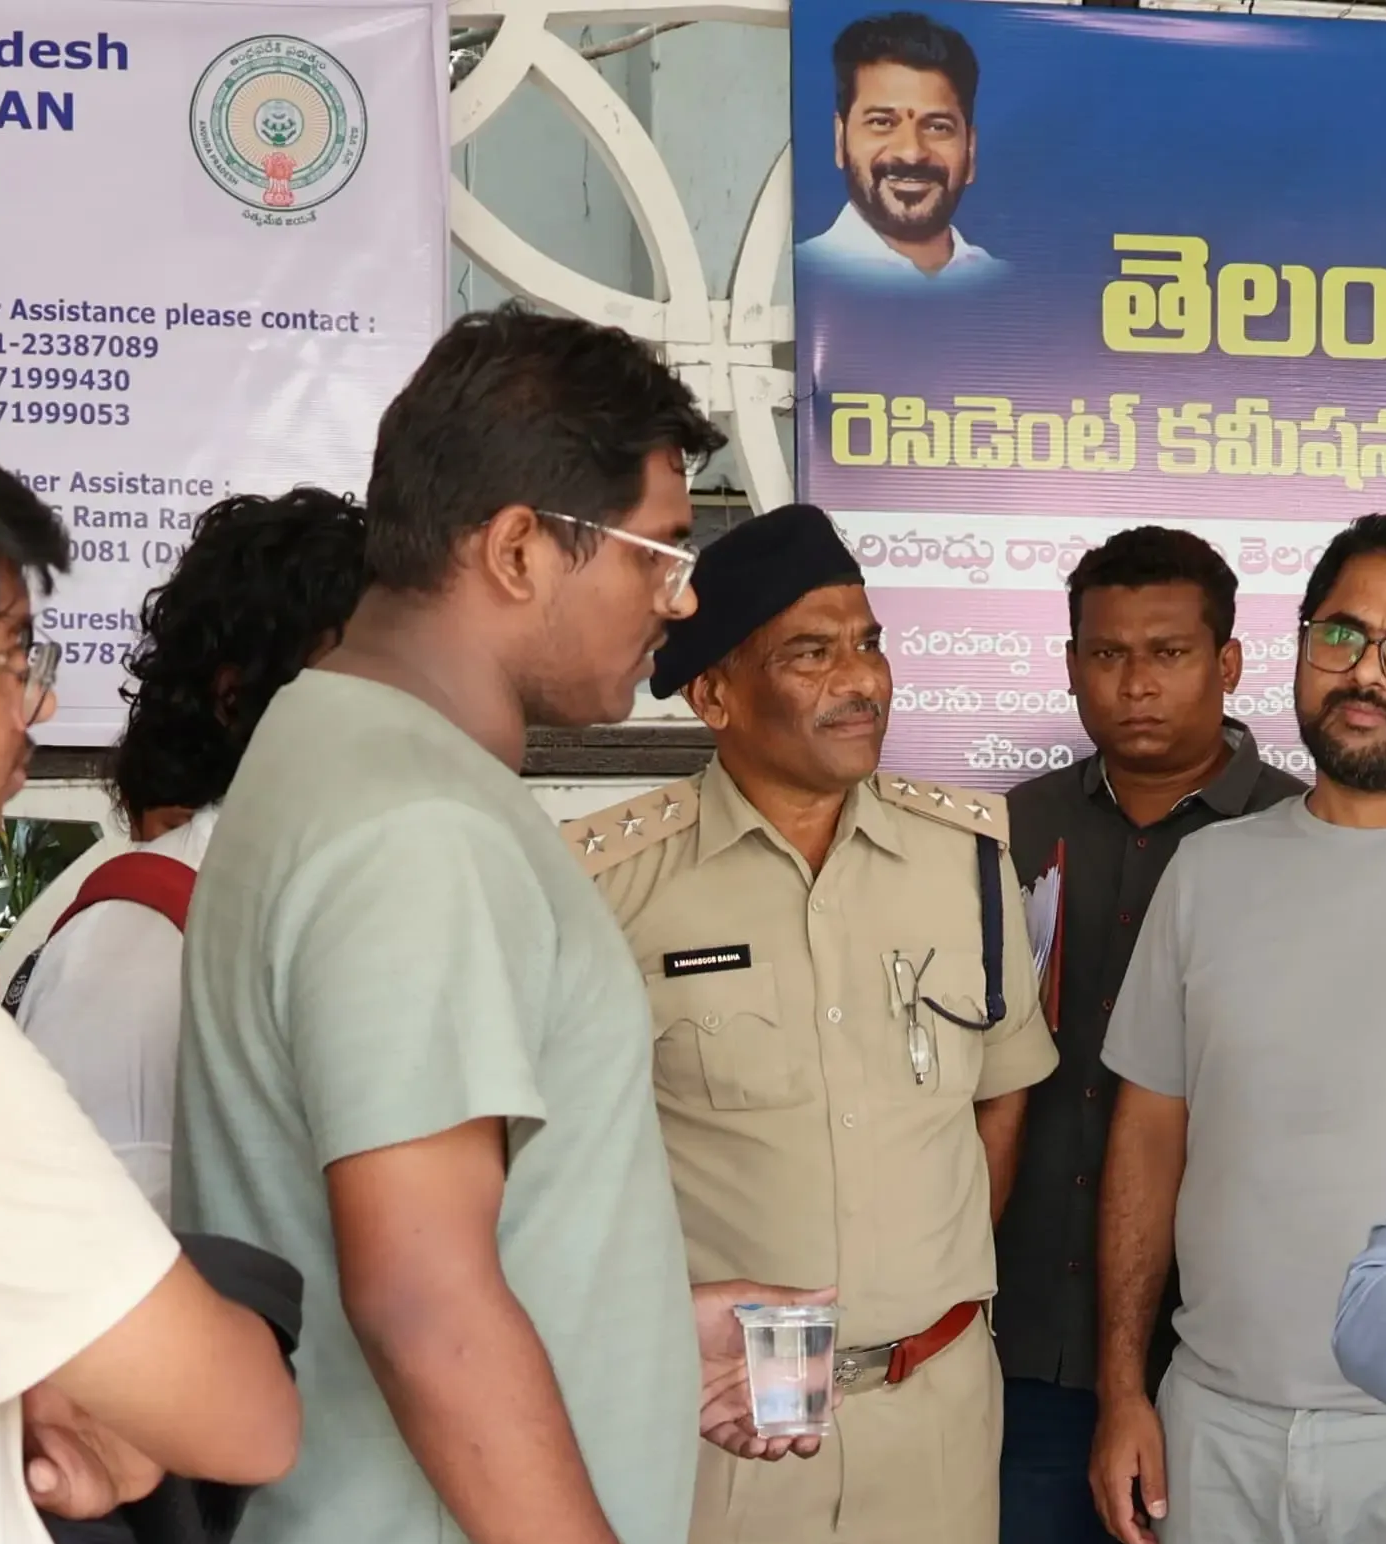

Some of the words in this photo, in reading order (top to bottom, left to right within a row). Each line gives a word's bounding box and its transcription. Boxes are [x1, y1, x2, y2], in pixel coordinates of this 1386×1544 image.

[198, 120, 213, 155] ANDHRA
[210, 154, 239, 185] PRADESH
[10, 299, 156, 324] Assistance
[165, 306, 253, 331] please
[261, 310, 359, 333] contact
[831, 391, 1141, 474] రెసిడెంట్
[69, 471, 214, 497] Assistance
[73, 505, 148, 529] Rama
[856, 529, 995, 584] రిహద్దు
[42, 607, 135, 631] Suresh
